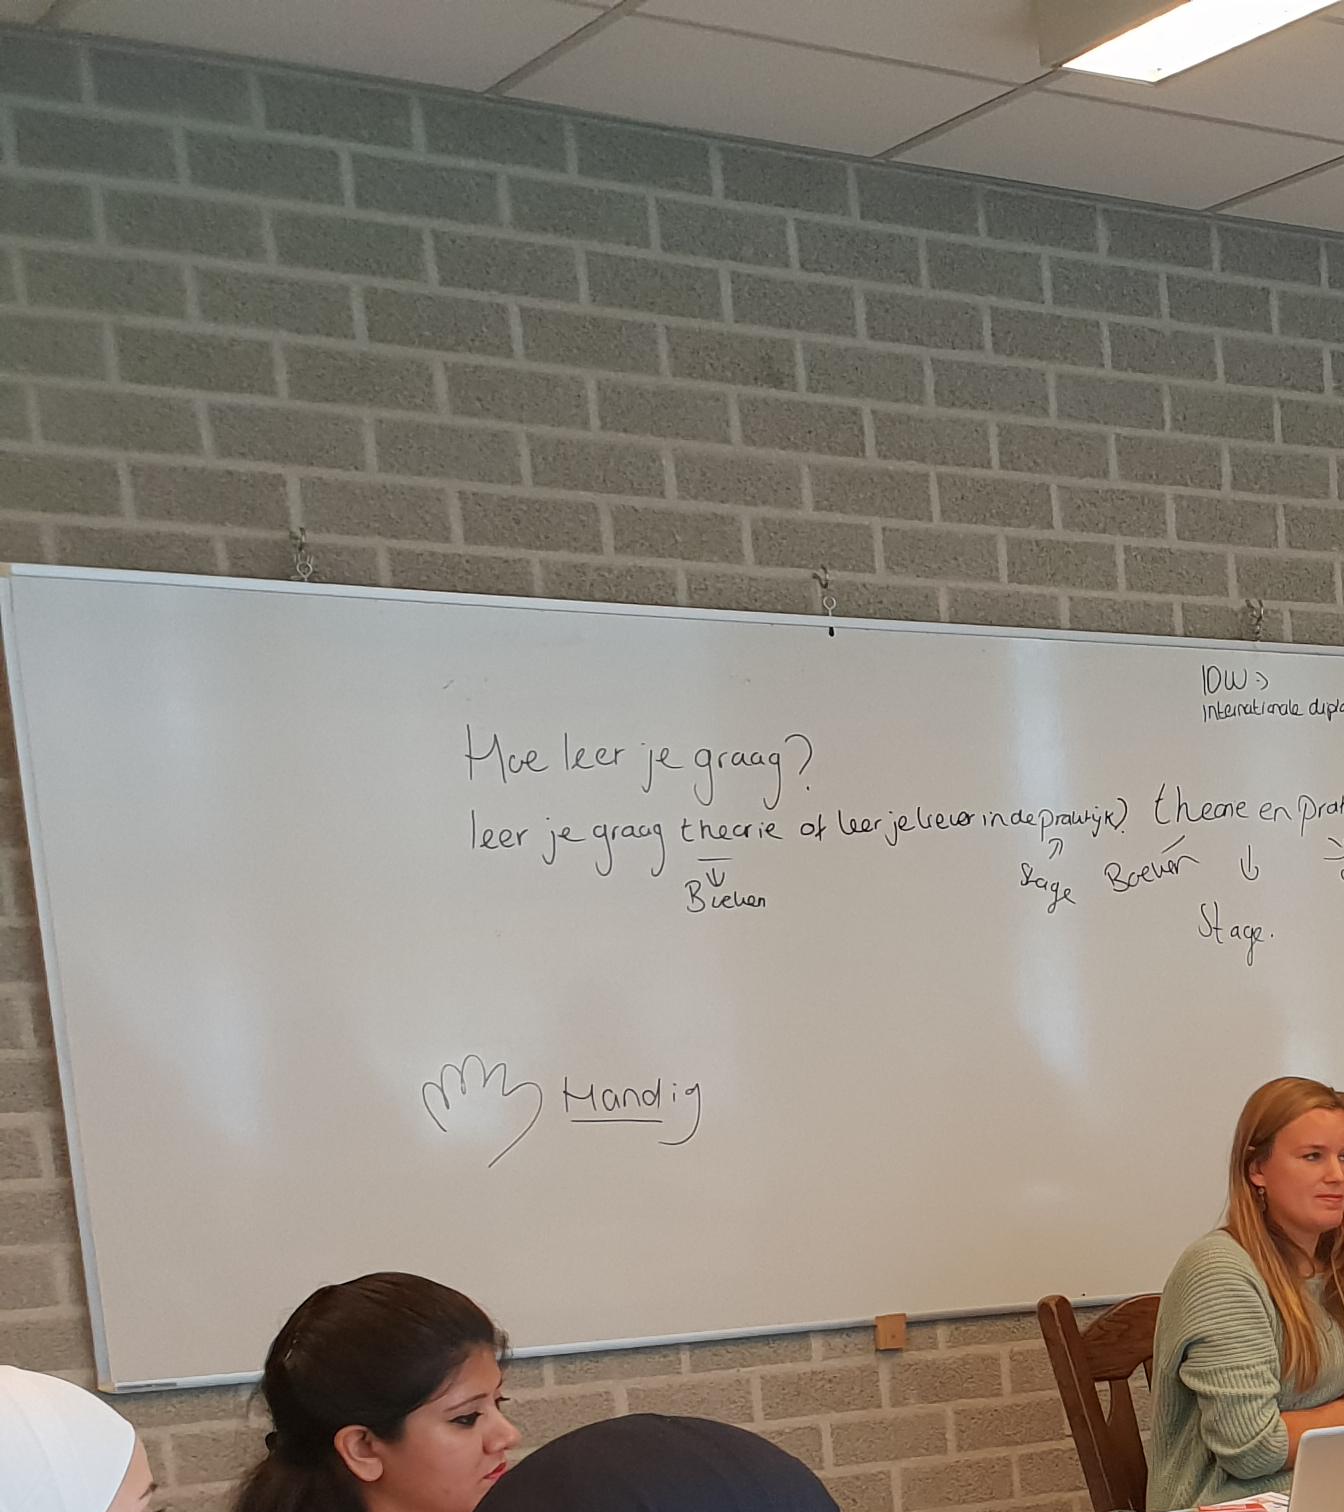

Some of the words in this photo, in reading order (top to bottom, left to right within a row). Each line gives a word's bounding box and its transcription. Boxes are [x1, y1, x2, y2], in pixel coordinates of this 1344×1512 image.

[465, 724, 548, 783] Hoe
[565, 733, 625, 770] leer
[641, 743, 683, 793] je
[694, 734, 813, 810] graag?
[472, 809, 528, 849] leer
[542, 817, 586, 865] je
[592, 823, 665, 877] graag
[682, 818, 783, 844] theorie
[800, 813, 827, 841] of
[838, 808, 883, 836] leer
[1259, 801, 1293, 822] en
[562, 1076, 701, 1145] Handig
